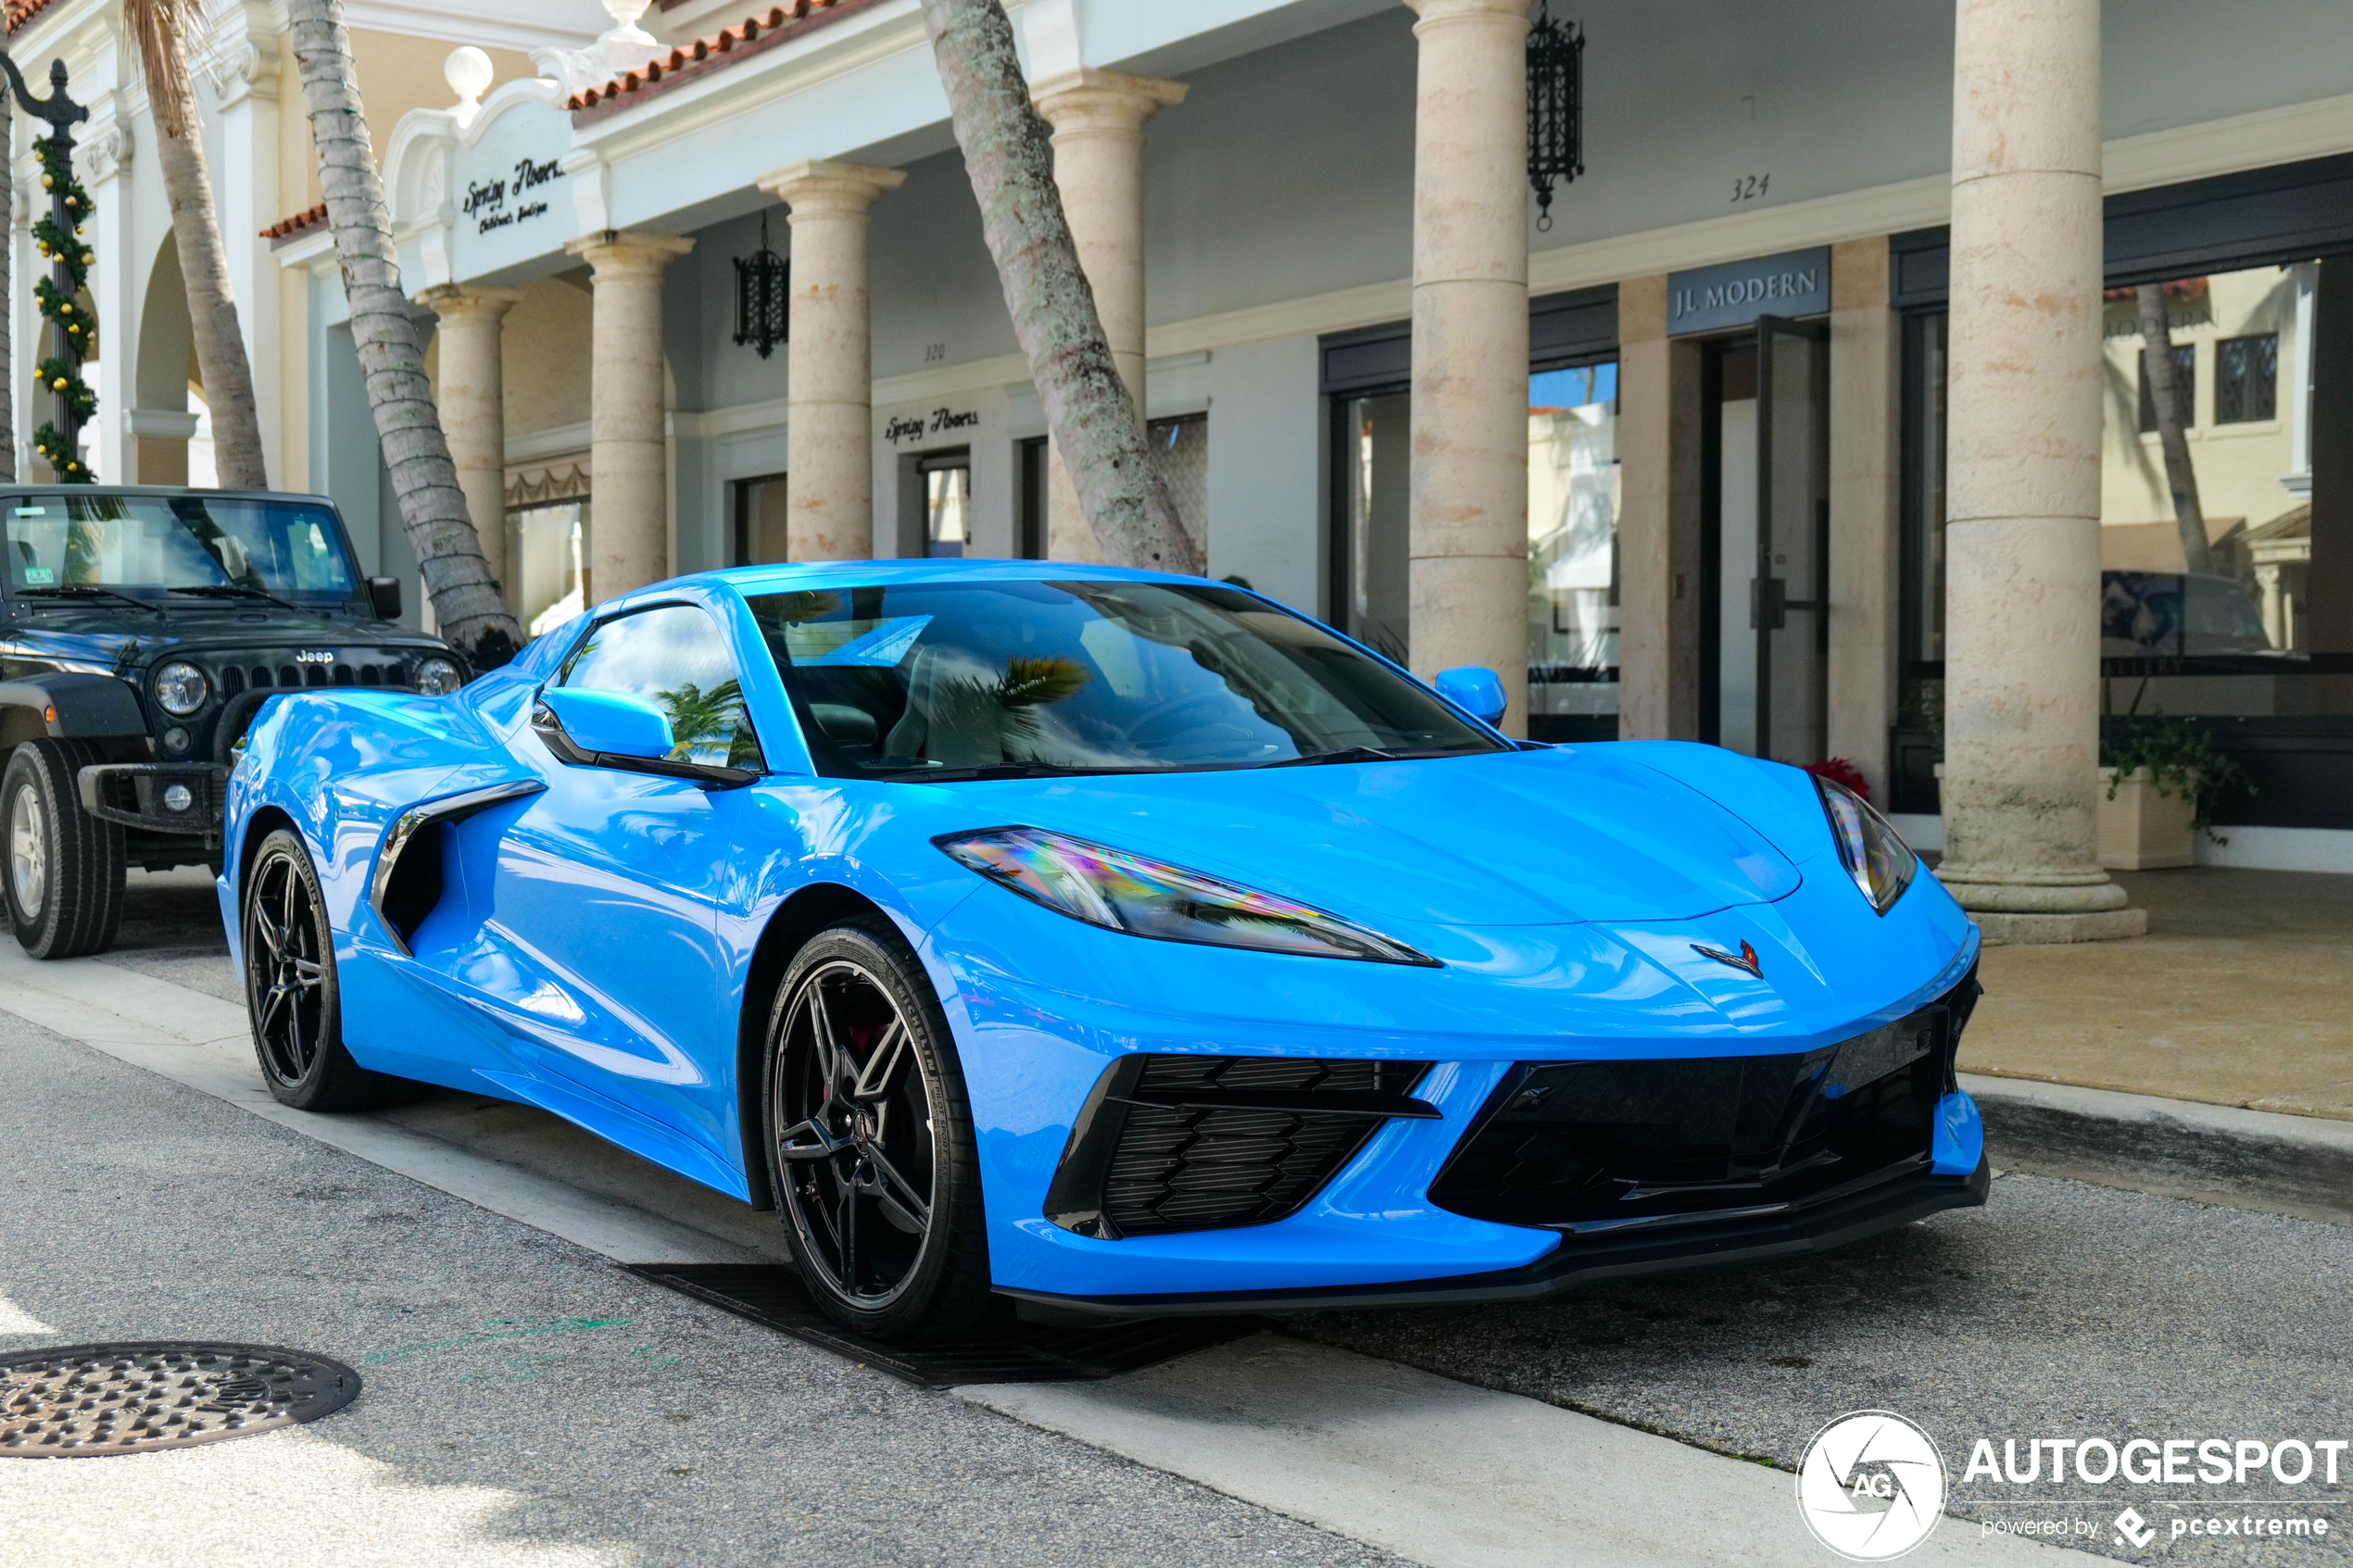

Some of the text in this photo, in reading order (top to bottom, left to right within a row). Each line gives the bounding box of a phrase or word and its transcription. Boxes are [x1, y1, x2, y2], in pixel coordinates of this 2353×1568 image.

[463, 179, 505, 220] Spring
[1730, 172, 1770, 203] 324
[1676, 269, 1818, 319] JL MODERN
[885, 408, 979, 445] Spring Flowers
[296, 649, 334, 664] Jeep
[896, 983, 937, 1072] MICHELIN
[935, 1085, 944, 1116] PILOT
